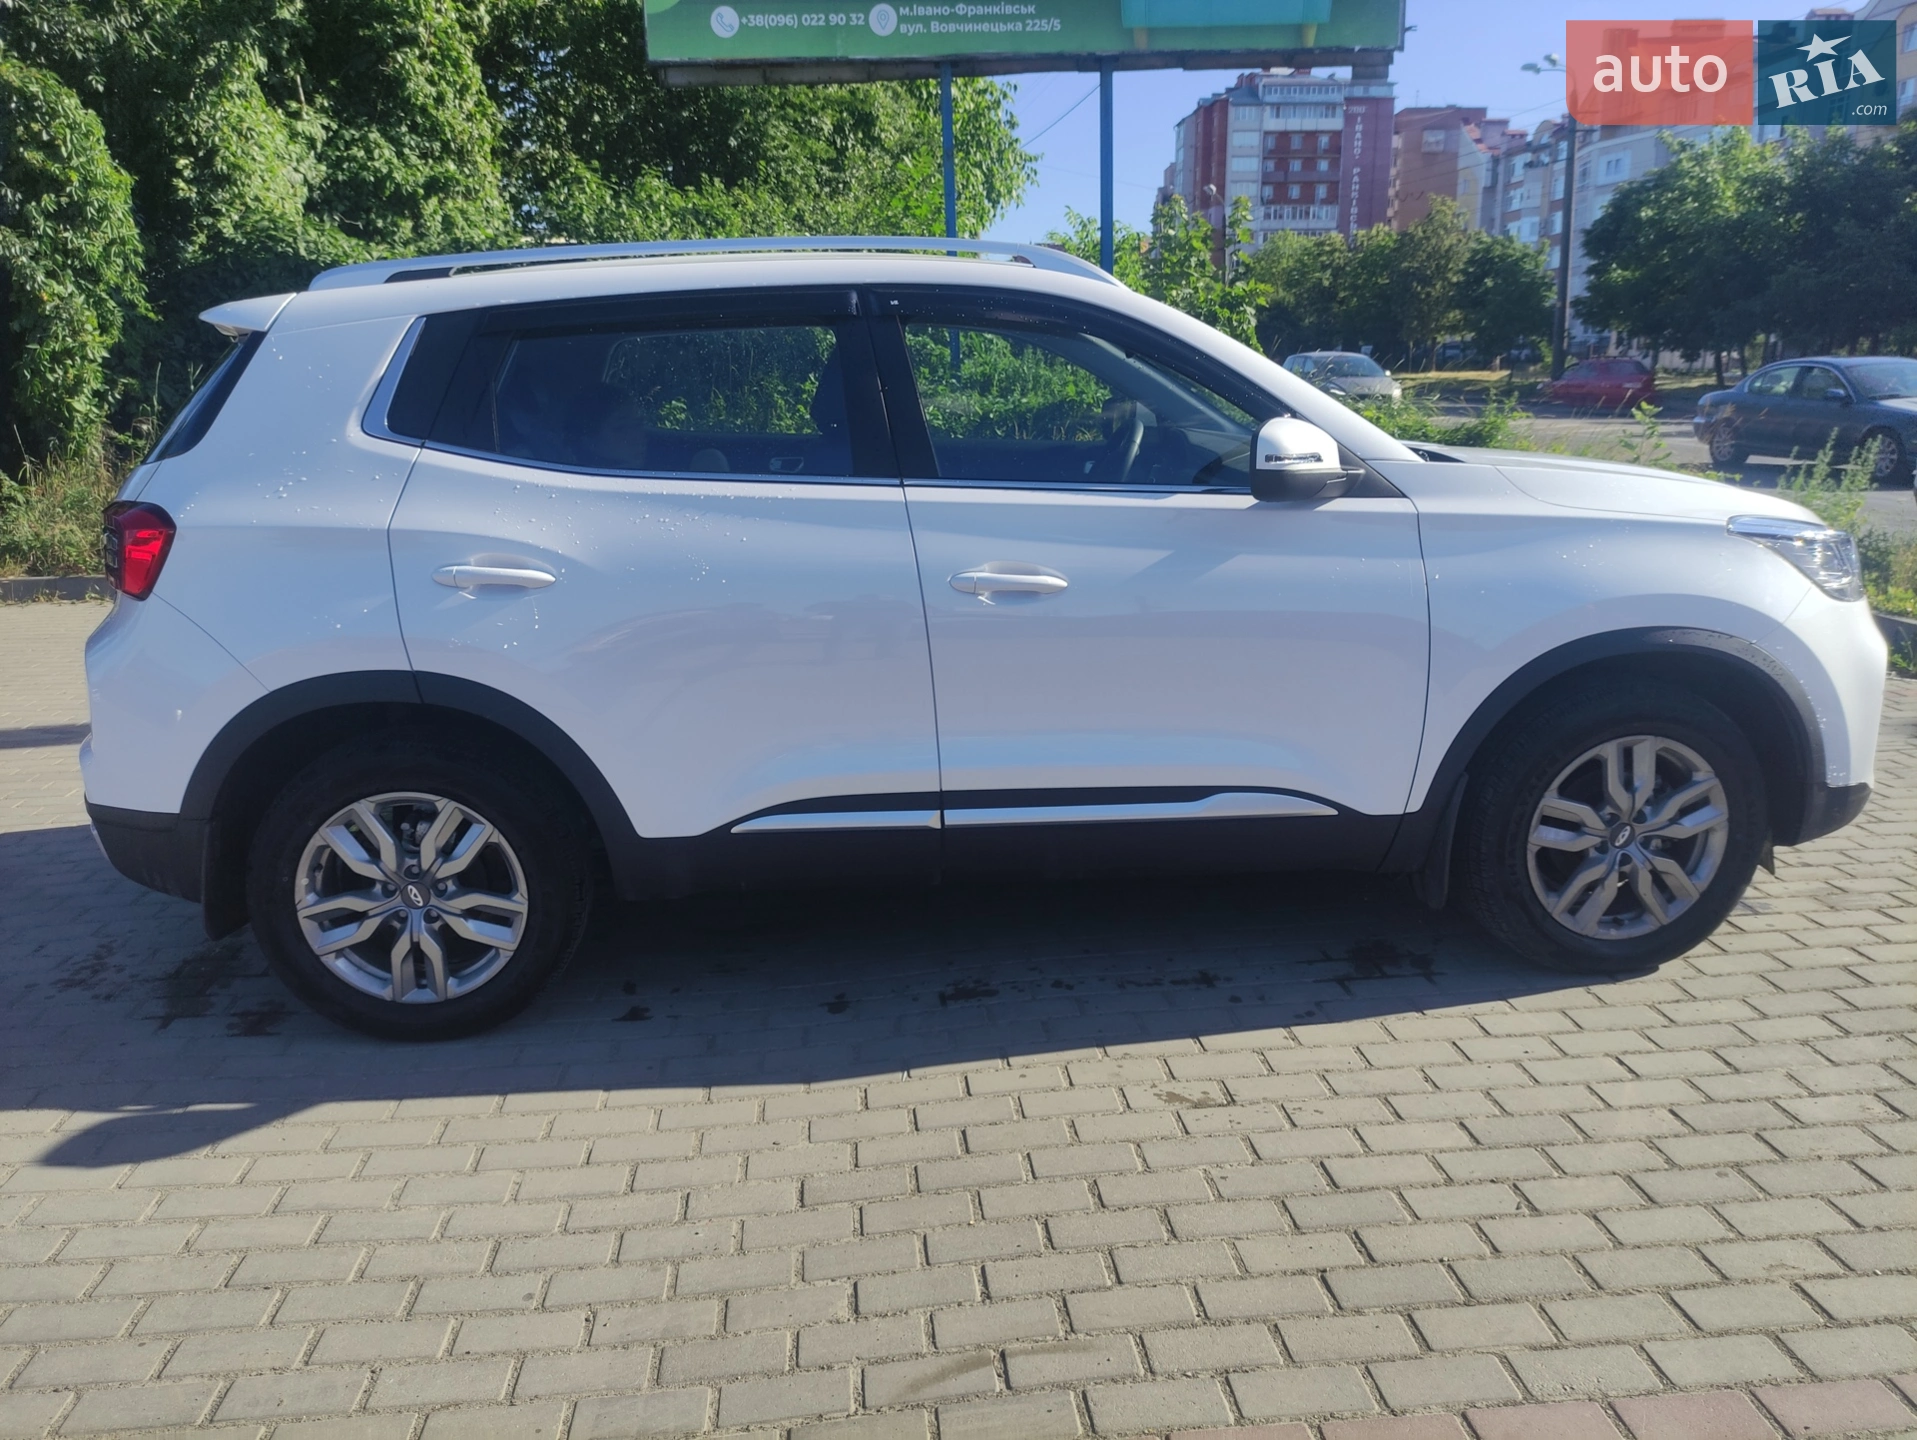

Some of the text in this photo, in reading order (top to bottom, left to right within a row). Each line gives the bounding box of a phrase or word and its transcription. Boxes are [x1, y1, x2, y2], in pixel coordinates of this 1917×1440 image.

[899, 2, 1036, 17] м.Івано-Франківськ
[740, 13, 865, 29] +38(096) 022 90 32
[900, 18, 1061, 36] вул. Вовчинецька 225/5
